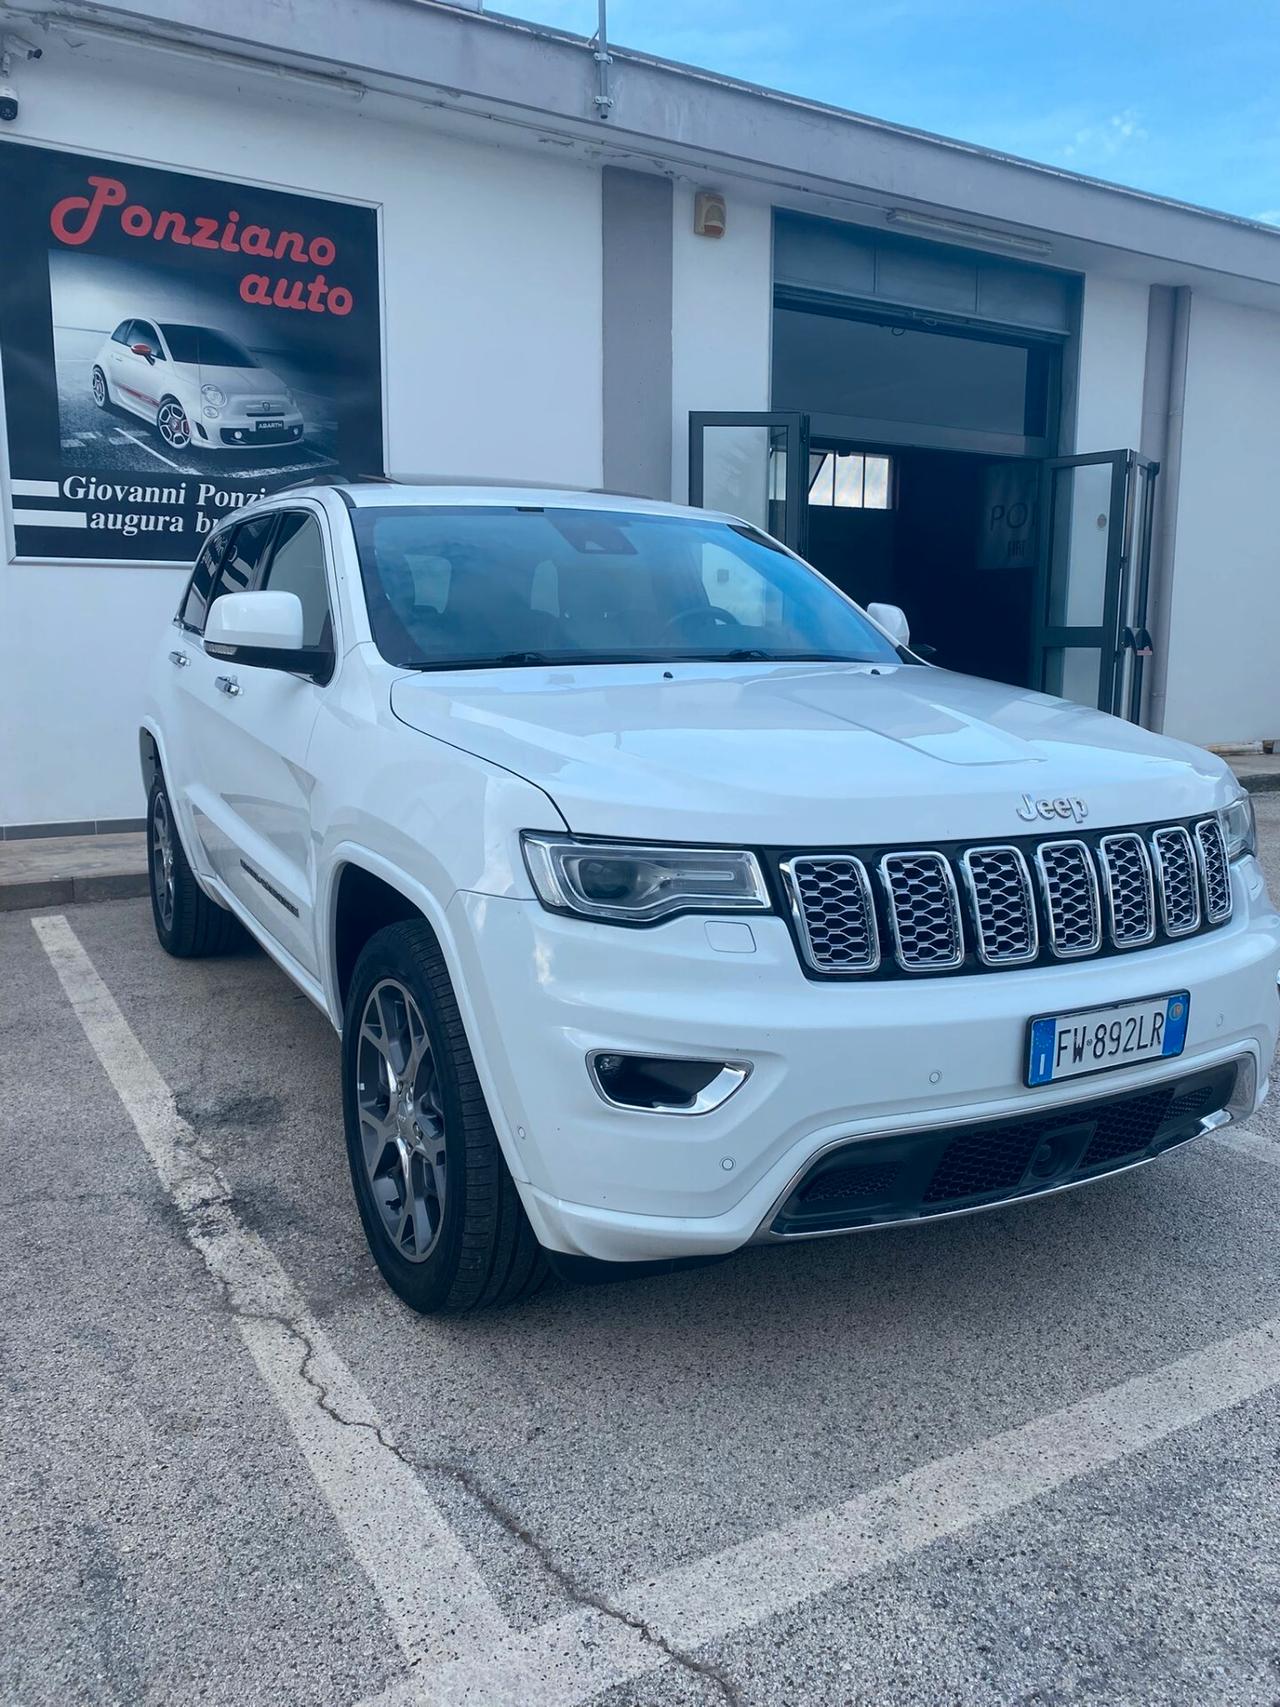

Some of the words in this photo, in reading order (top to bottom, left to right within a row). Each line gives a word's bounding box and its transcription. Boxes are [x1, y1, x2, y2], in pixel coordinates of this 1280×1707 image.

[50, 175, 336, 266] Ponziano
[239, 272, 353, 315] auto
[63, 475, 187, 505] Giovanni
[90, 511, 184, 537] augura
[1016, 793, 1088, 824] Jeep
